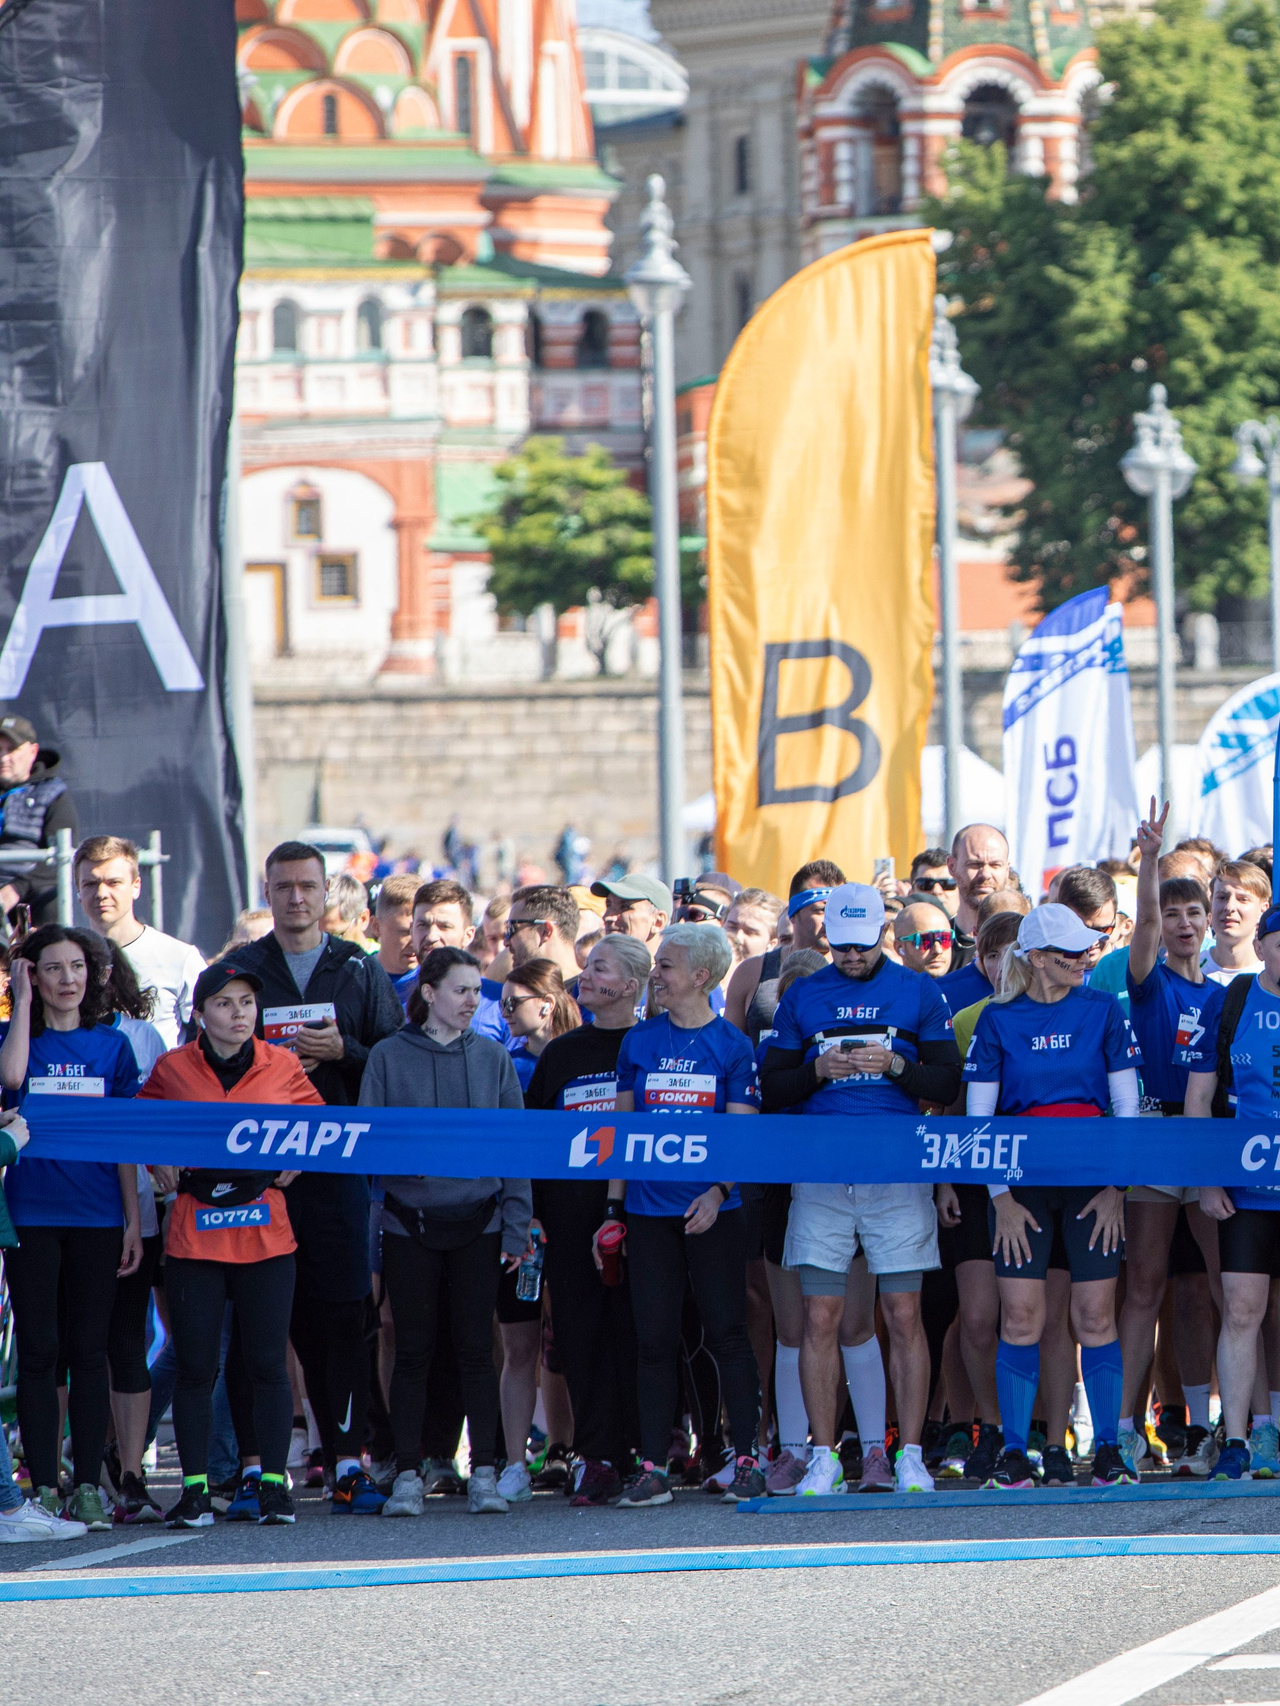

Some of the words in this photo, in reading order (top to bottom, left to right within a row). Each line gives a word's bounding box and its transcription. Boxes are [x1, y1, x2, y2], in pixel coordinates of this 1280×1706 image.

[1044, 734, 1078, 848] ПСБ
[1254, 1011, 1280, 1029] 10
[226, 1119, 371, 1158] СТАРТ
[625, 1133, 708, 1164] ПСБ
[215, 1183, 233, 1191] NIKE
[202, 1208, 262, 1225] 10774
